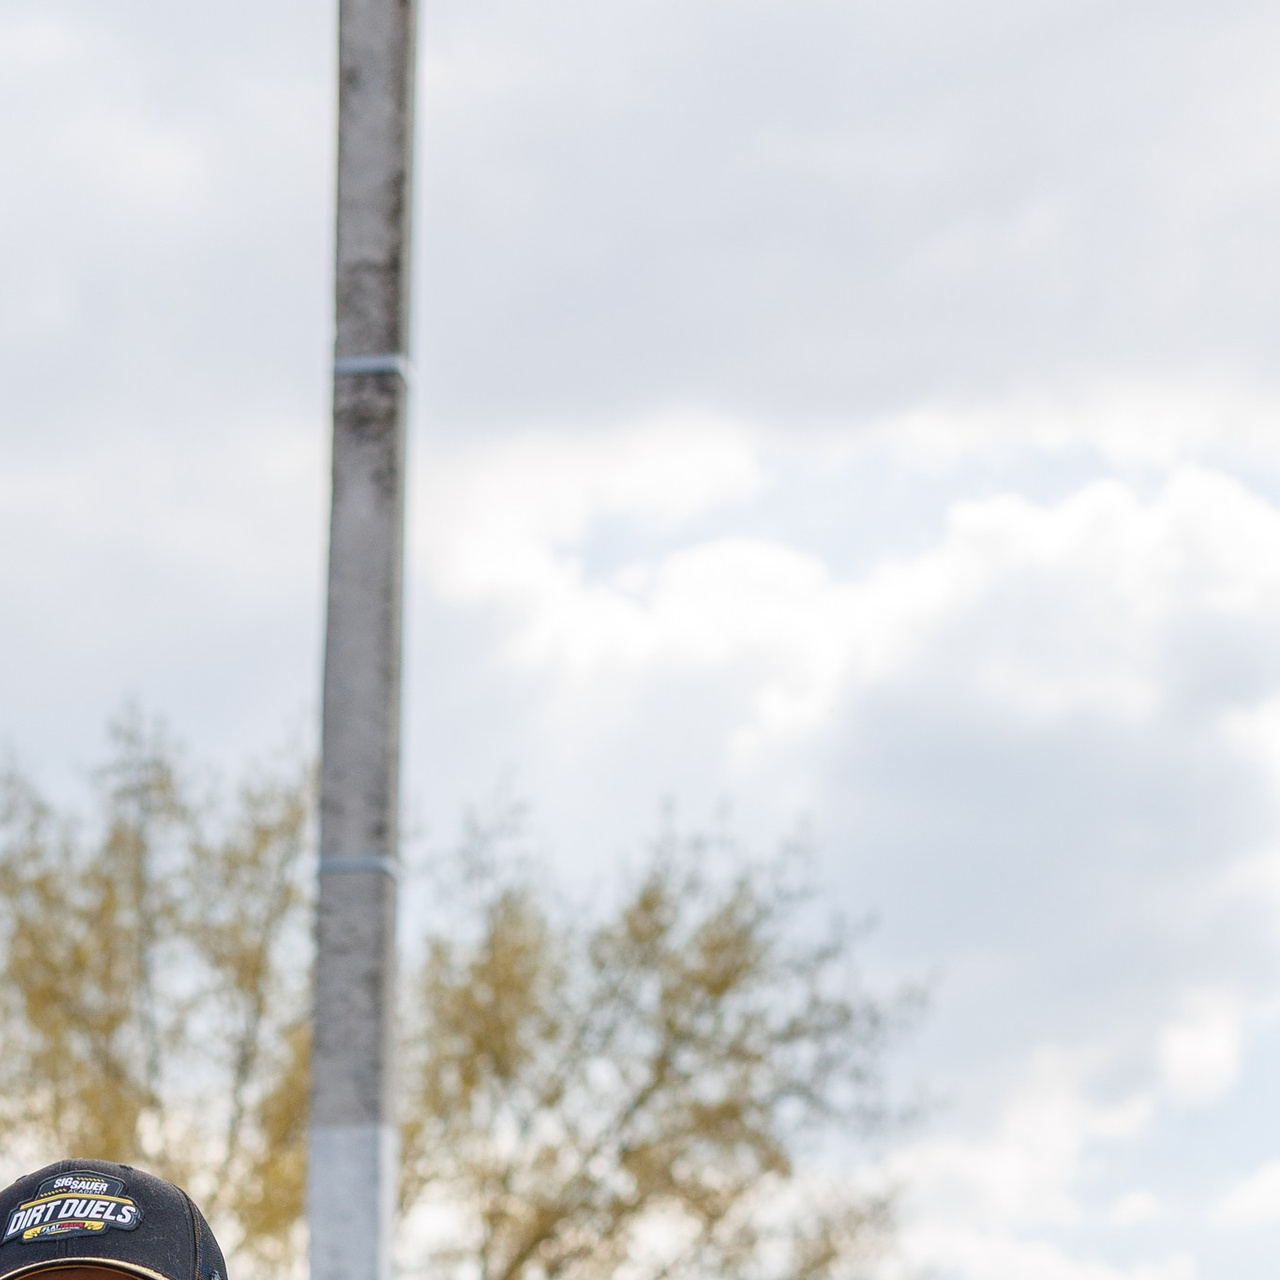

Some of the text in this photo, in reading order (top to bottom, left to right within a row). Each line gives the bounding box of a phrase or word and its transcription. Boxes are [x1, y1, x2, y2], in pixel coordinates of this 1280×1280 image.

[53, 1177, 109, 1192] SIG SAUER
[7, 1199, 136, 1236] DIRT DUELS
